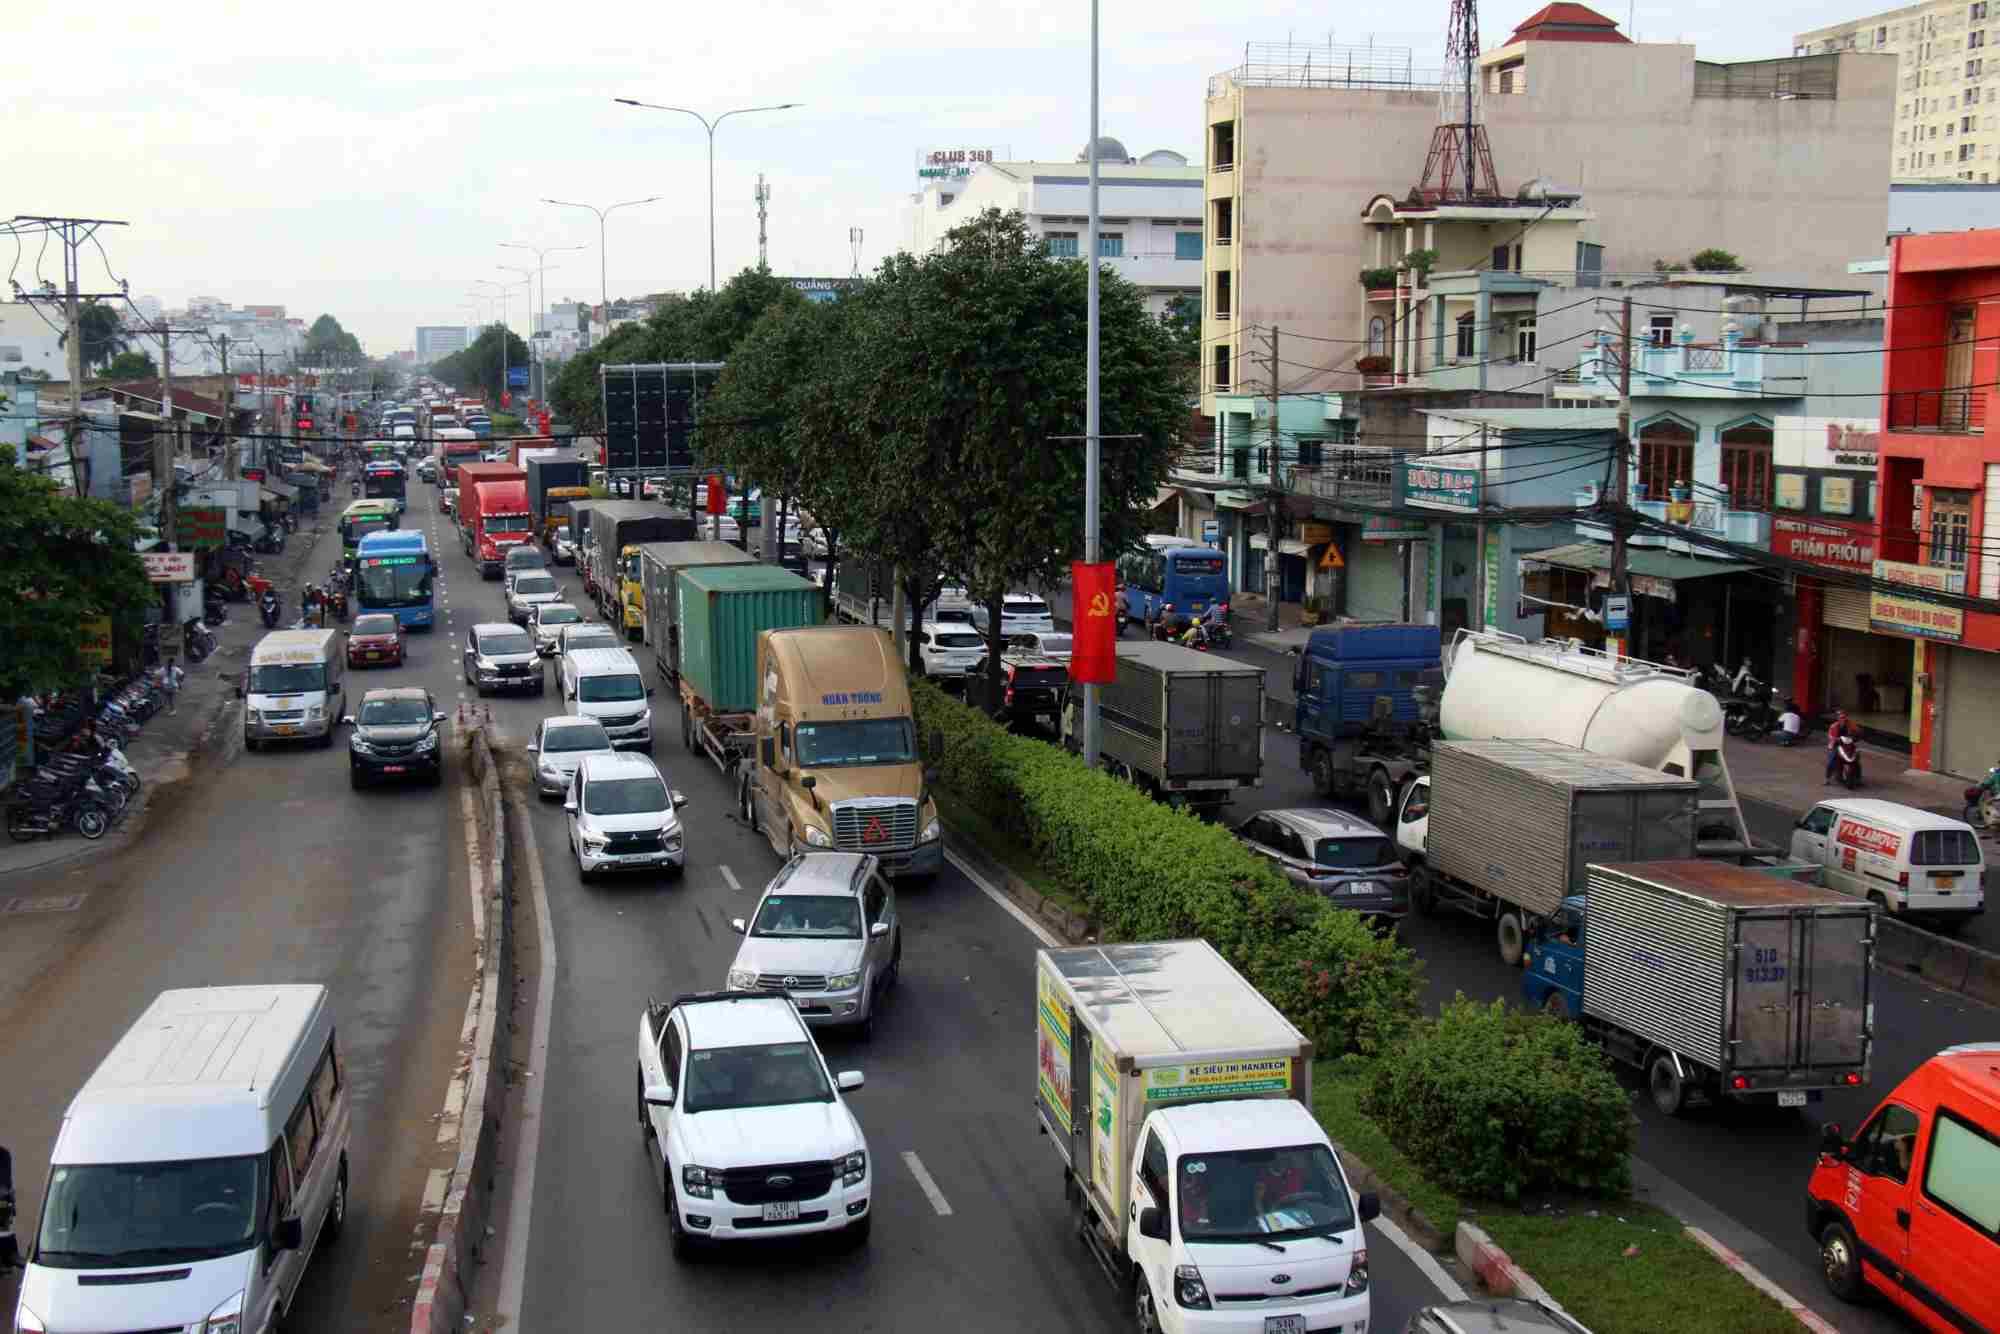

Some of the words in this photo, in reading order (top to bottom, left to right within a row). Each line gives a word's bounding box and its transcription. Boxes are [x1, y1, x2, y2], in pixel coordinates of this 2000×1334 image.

[933, 150, 966, 162] CLUB
[969, 149, 993, 162] 368
[1791, 537, 1825, 558] PHÂN
[1828, 538, 1858, 562] PHỐI
